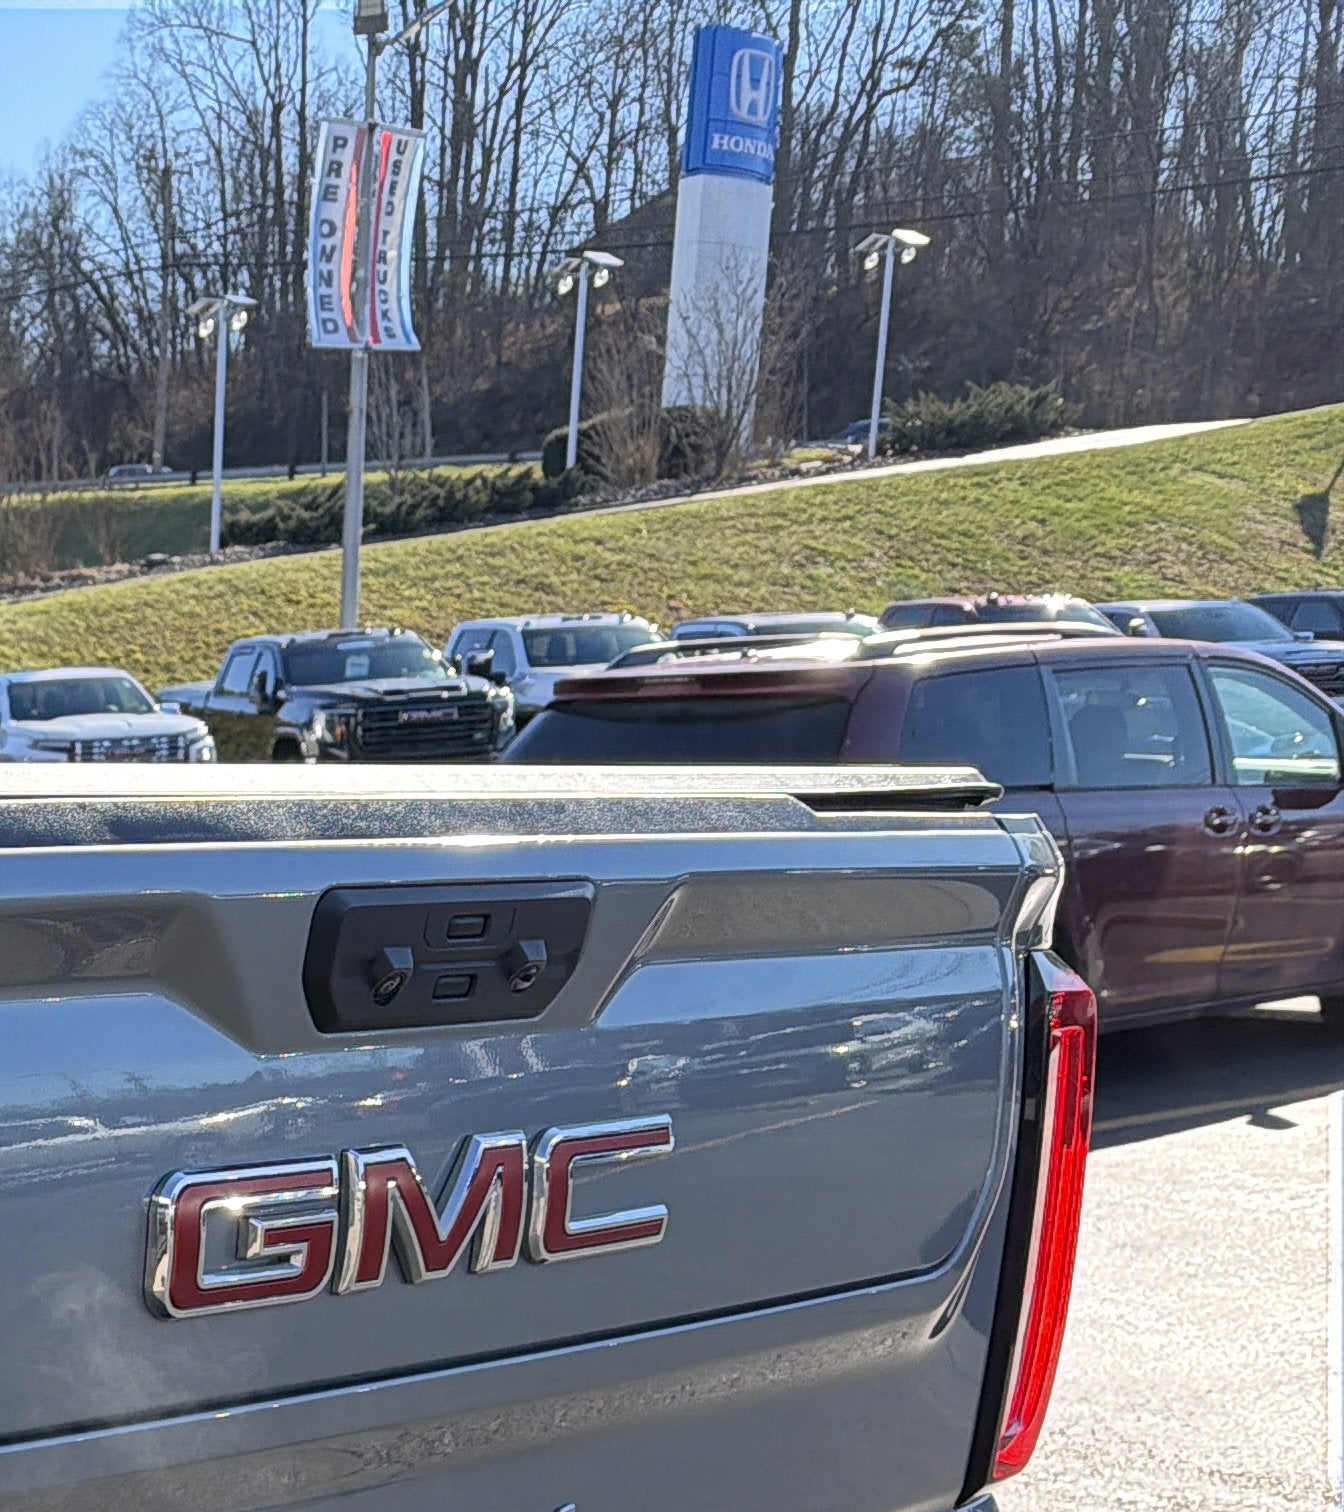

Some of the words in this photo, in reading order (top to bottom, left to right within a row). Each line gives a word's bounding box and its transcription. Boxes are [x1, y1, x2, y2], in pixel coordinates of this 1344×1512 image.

[322, 136, 349, 202] PRE
[385, 138, 408, 216] USED
[711, 133, 774, 160] HONDA
[377, 230, 396, 339] TRUCKS
[144, 1114, 673, 1320] GMC
